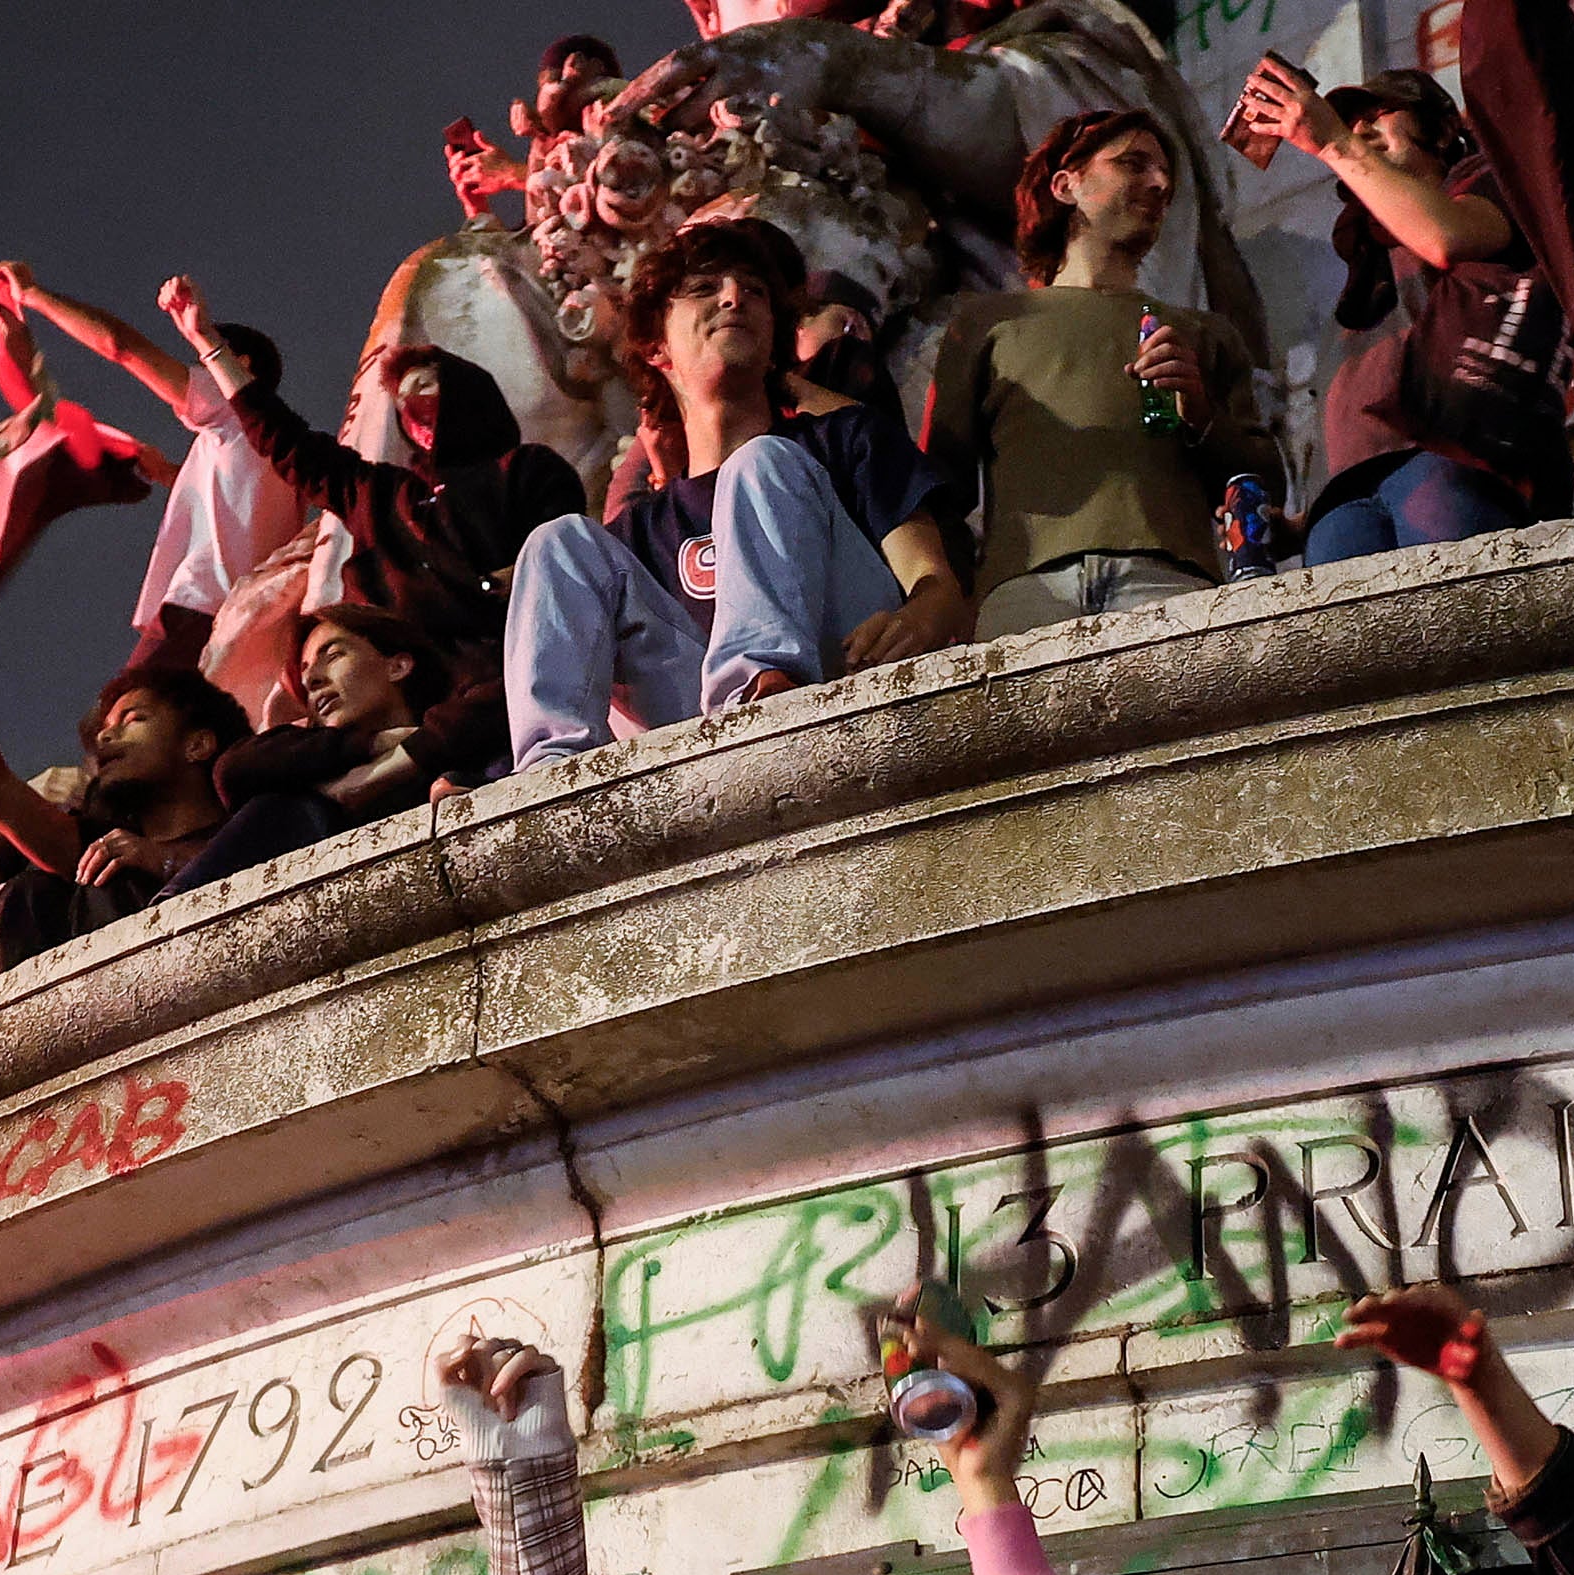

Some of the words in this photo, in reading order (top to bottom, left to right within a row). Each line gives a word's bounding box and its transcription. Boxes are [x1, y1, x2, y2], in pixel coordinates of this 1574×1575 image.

[945, 1183, 1081, 1322] 13
[126, 1350, 385, 1529] 1792
[1207, 1420, 1362, 1488] FREE
